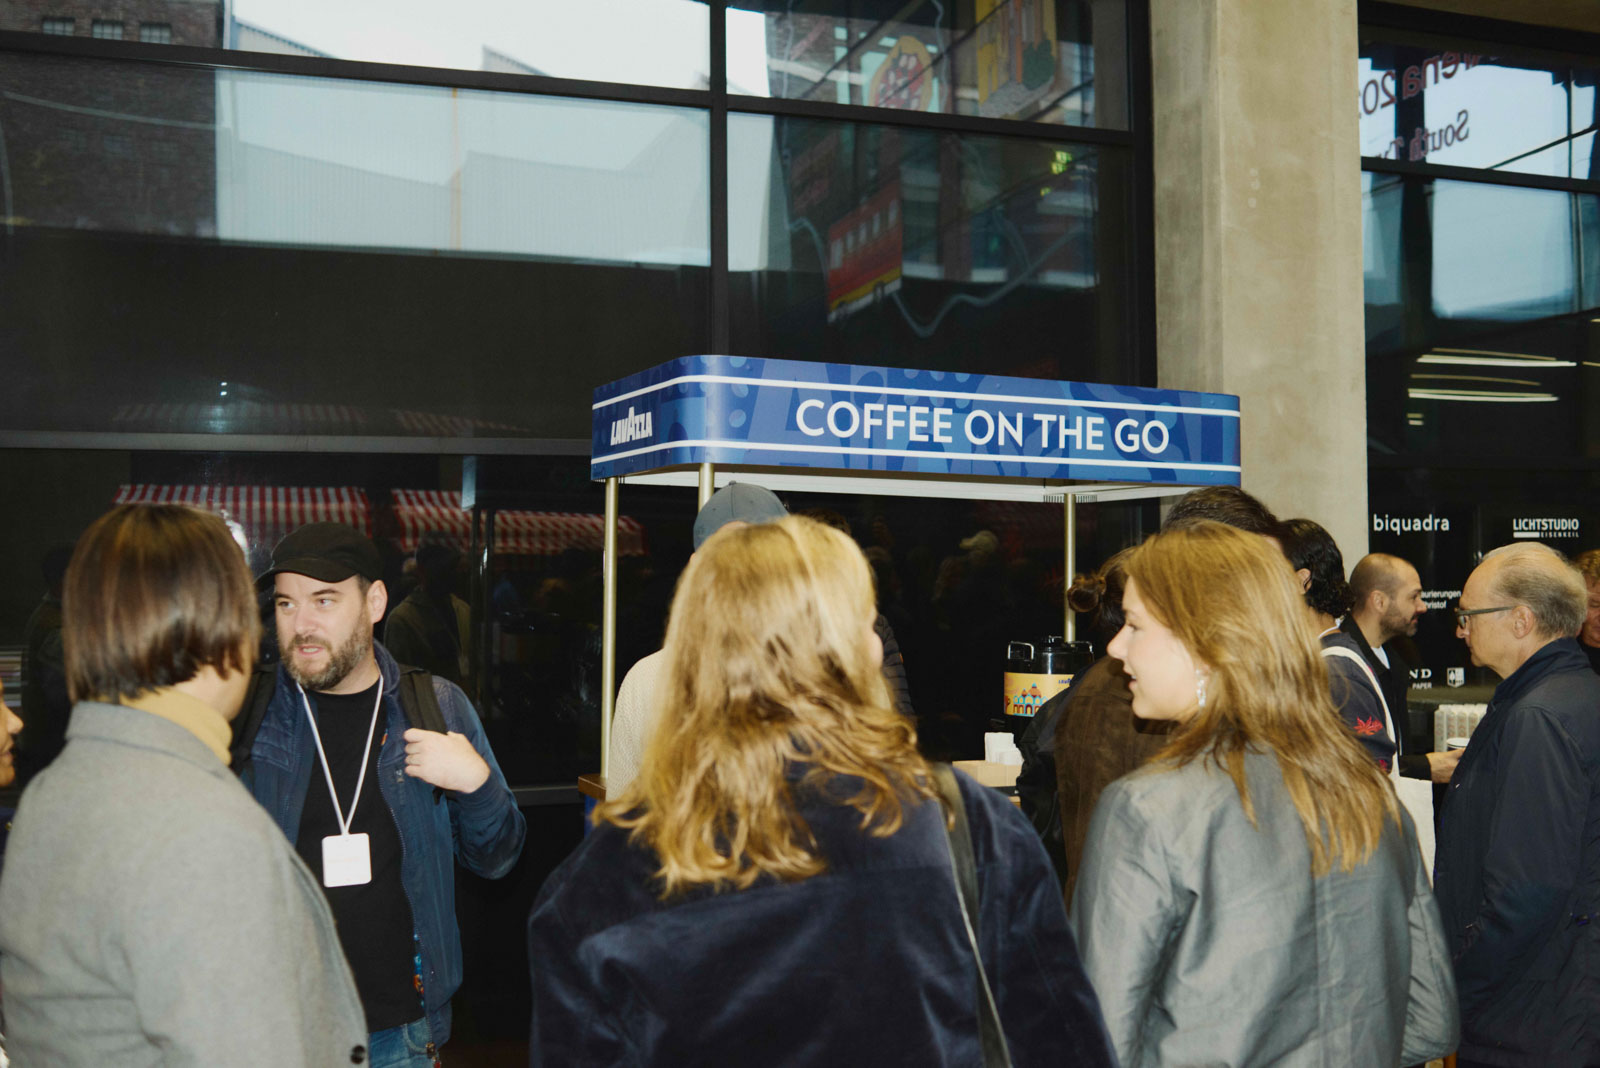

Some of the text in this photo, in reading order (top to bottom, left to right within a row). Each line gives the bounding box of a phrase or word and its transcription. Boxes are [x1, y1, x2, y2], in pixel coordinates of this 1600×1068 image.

[610, 406, 653, 446] LAVAZZA
[796, 398, 1170, 455] COFFEE ON THE GO
[1373, 514, 1450, 535] biquadra
[1512, 518, 1580, 531] LICHTSTUDIO
[1420, 590, 1462, 600] aurierungen
[1423, 600, 1447, 609] hristof
[1408, 668, 1432, 679] ND
[1411, 681, 1433, 690] PAPER
